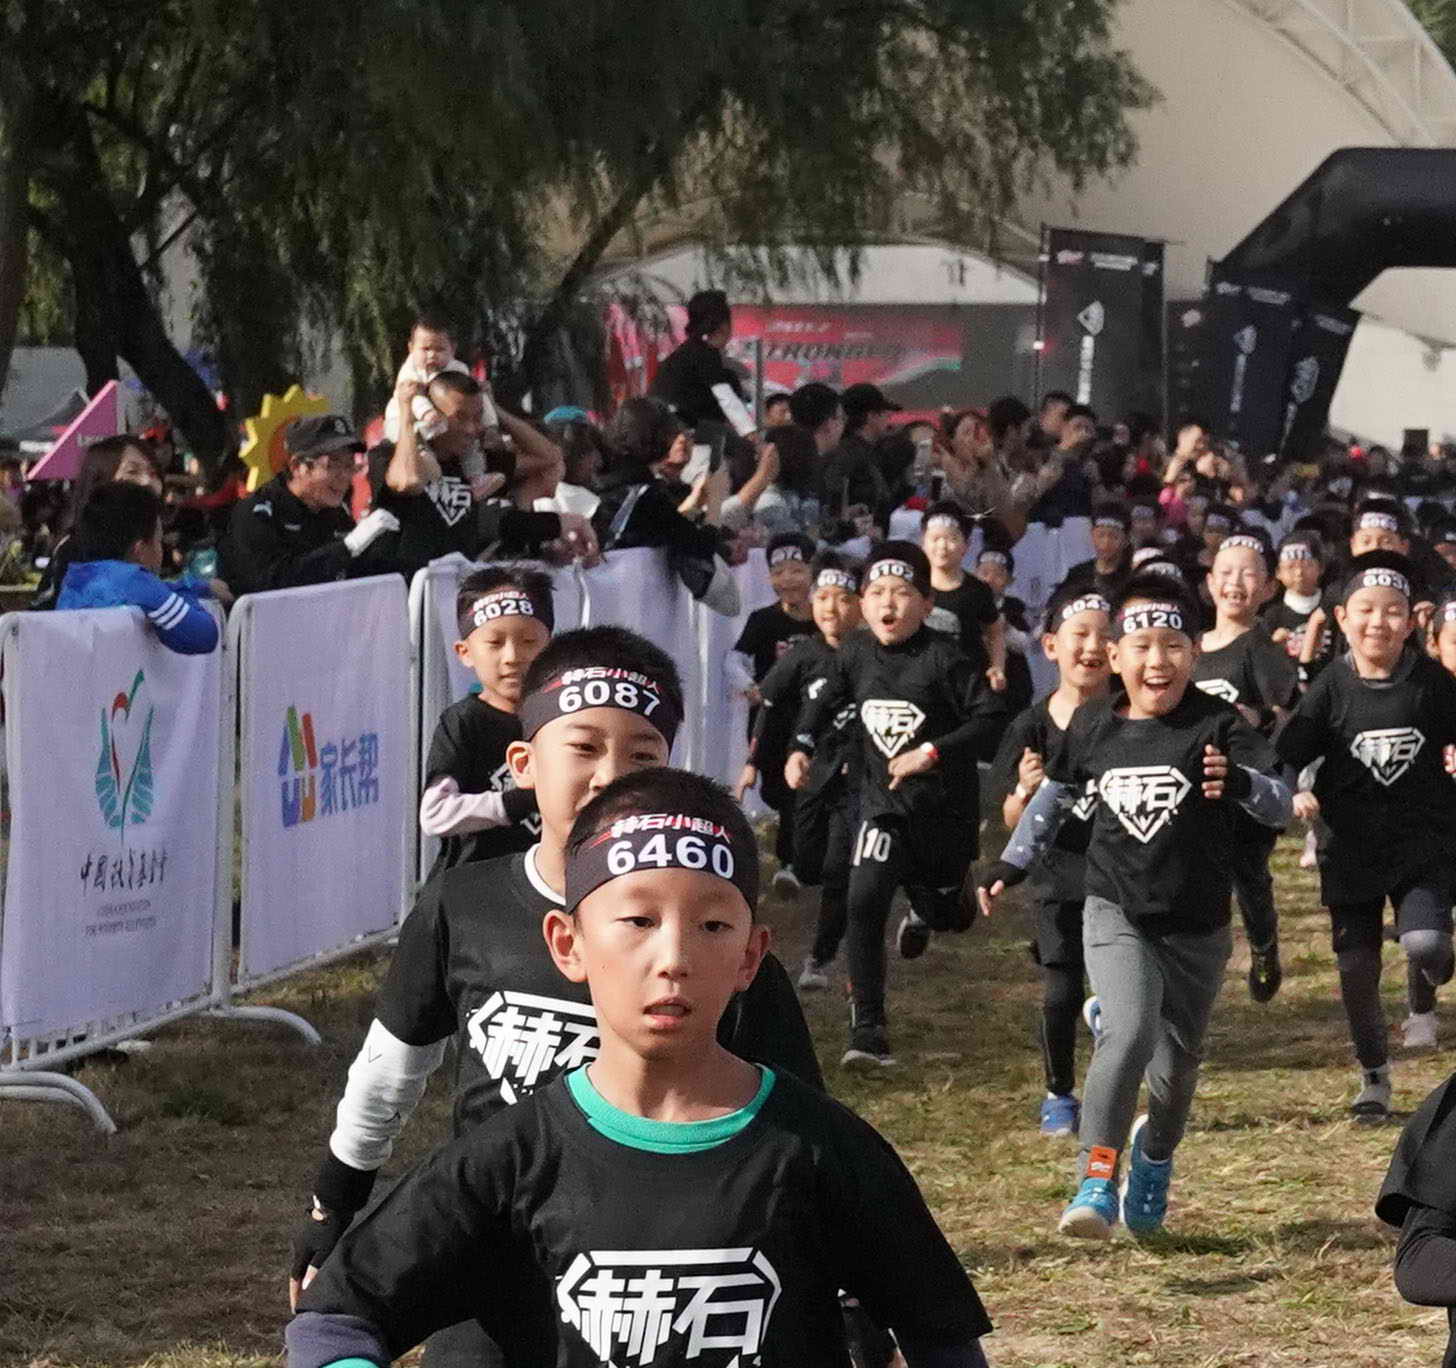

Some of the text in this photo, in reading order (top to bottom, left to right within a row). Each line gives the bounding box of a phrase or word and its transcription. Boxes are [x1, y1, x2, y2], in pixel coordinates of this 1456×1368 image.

[474, 600, 534, 627] 6028
[1122, 612, 1183, 634] 6120
[558, 680, 661, 716] 6087
[607, 833, 735, 880] 6460
[574, 1268, 766, 1366] 赫石
